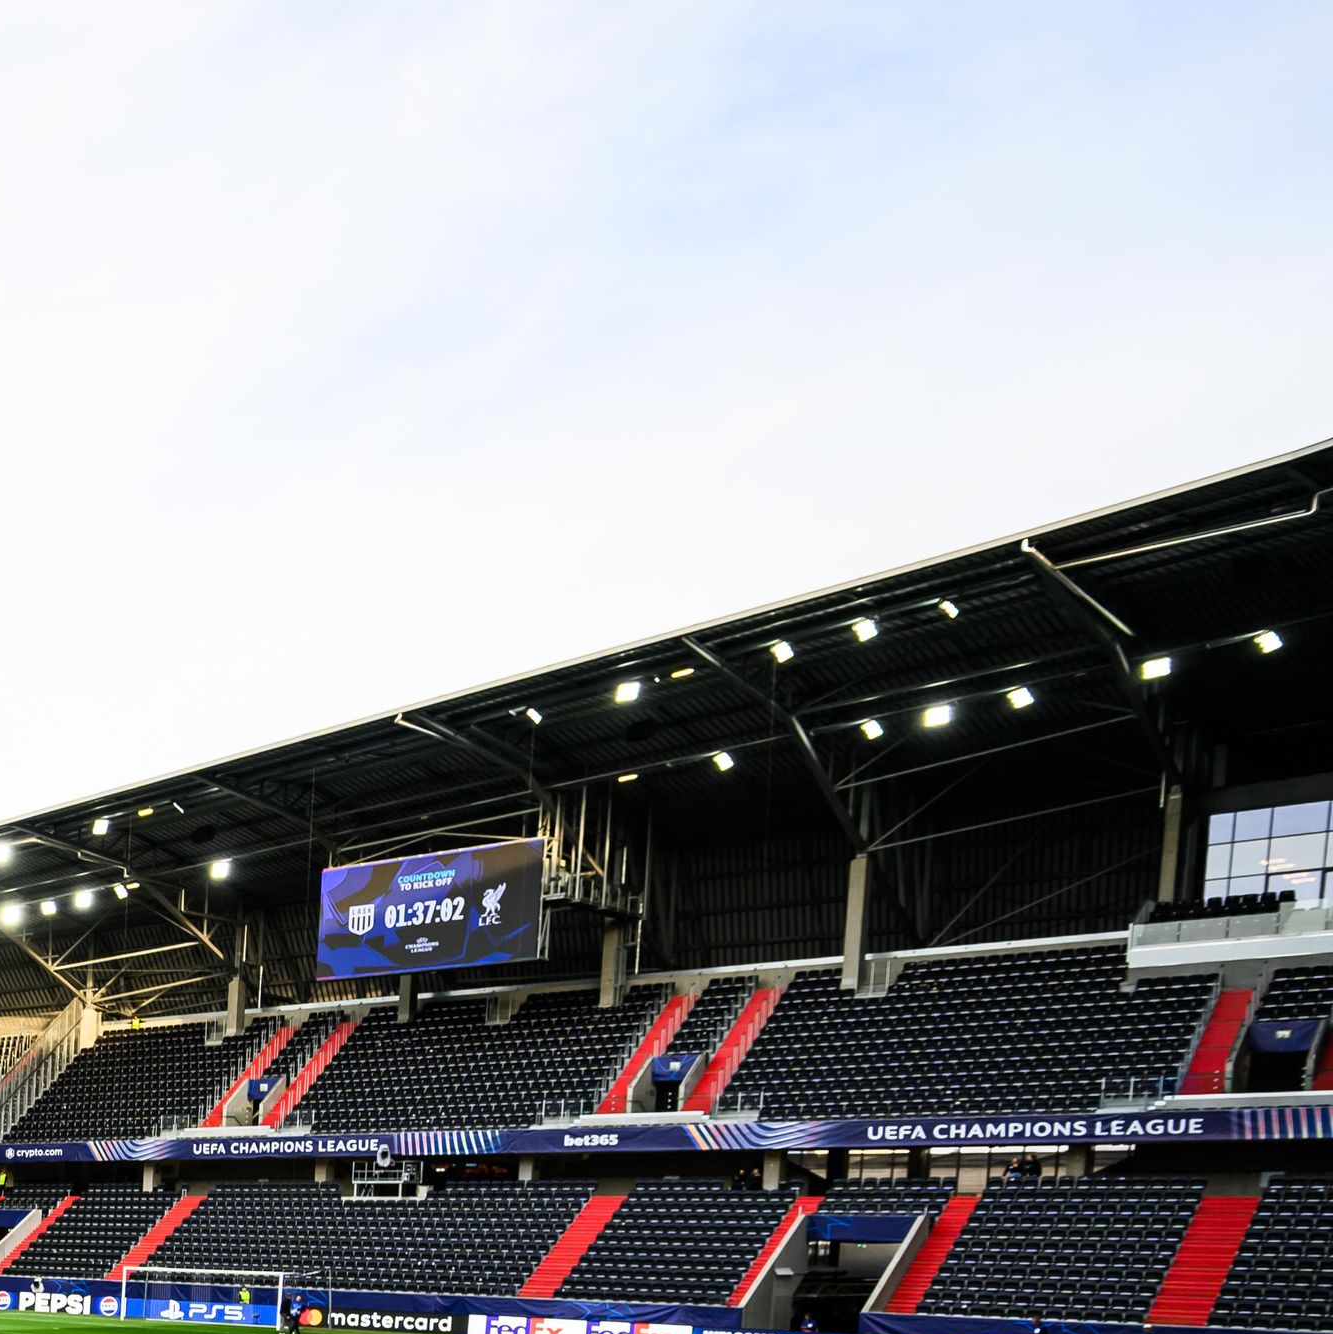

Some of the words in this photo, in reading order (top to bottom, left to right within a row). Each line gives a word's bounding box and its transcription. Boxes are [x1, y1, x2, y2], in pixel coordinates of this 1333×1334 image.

[398, 869, 455, 884] COUNTDOWN
[400, 883, 412, 891] TO
[413, 880, 434, 889] KICK
[436, 877, 452, 887] OFF
[384, 897, 465, 929] 01:37:02
[866, 1125, 927, 1141] UEFA
[932, 1120, 1086, 1139] CHAMPIONS
[1094, 1118, 1204, 1137] LEAGUE
[192, 1143, 226, 1155] UEFA
[231, 1140, 313, 1154] CHAMPIONS
[318, 1138, 379, 1152] LEAGUE
[563, 1133, 619, 1147] bet365
[16, 1147, 63, 1158] crypto.com
[19, 1291, 91, 1315] PEPSI
[328, 1311, 452, 1333] mastercard
